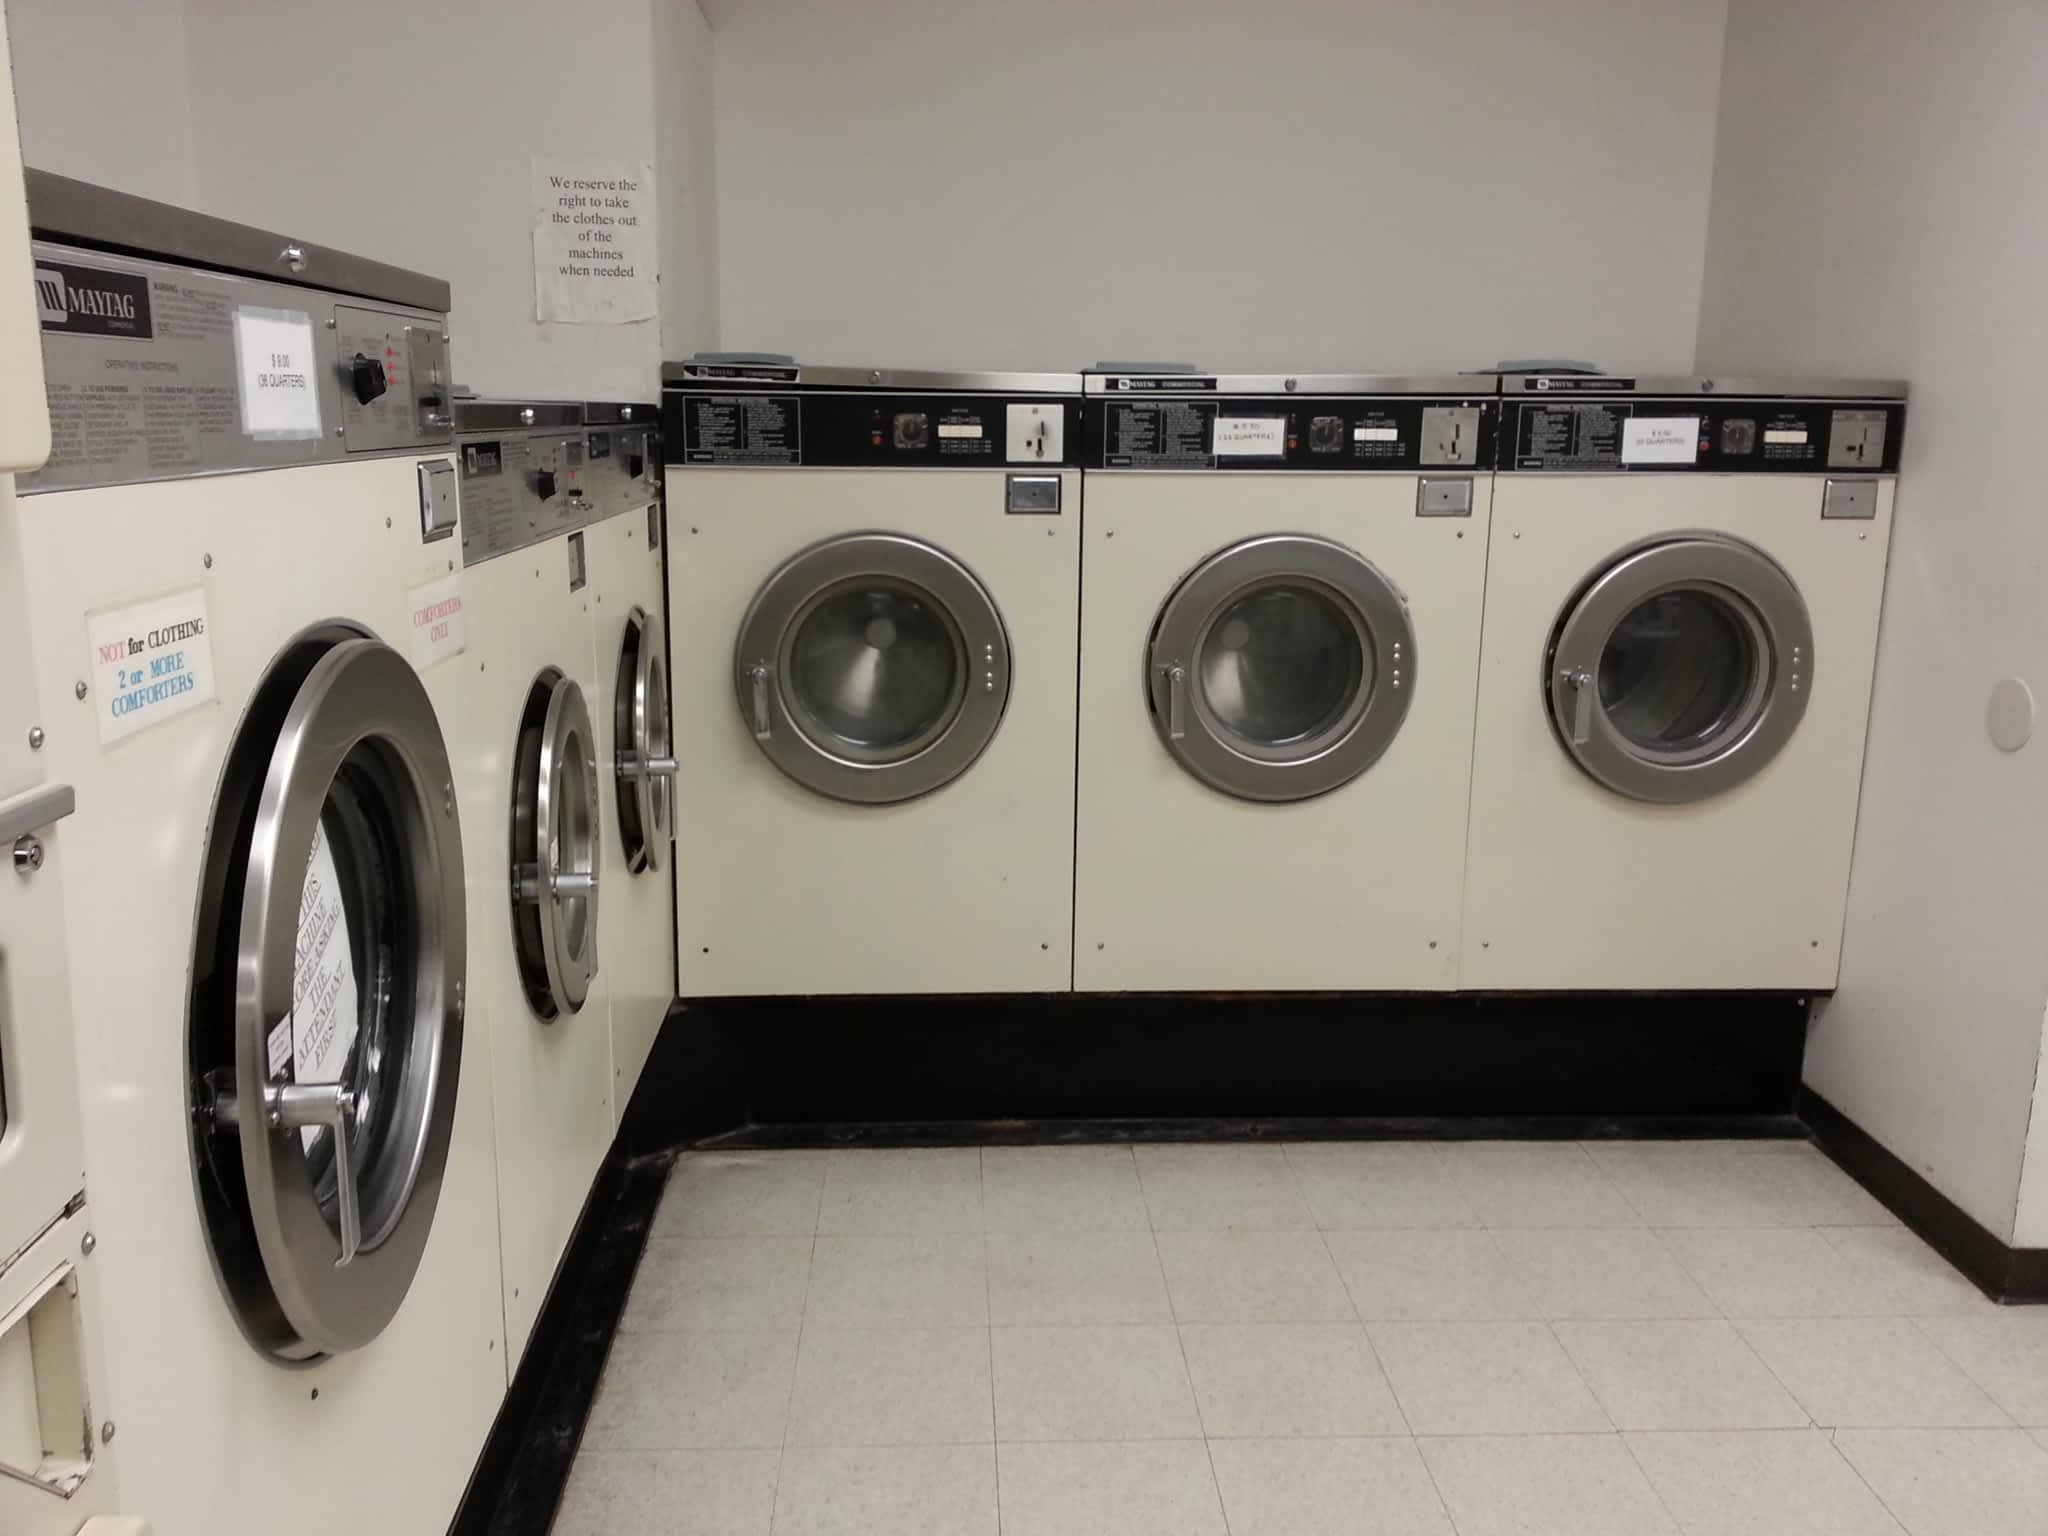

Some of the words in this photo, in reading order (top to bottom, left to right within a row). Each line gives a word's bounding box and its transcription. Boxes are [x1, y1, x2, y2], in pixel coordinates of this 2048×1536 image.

[550, 176, 570, 189] We
[573, 180, 616, 191] reserve
[619, 179, 637, 191] the
[558, 195, 586, 209] right
[590, 196, 602, 208] to
[605, 196, 629, 208] take
[552, 212, 570, 224] the
[573, 213, 615, 225] clothes
[618, 216, 637, 226] out
[578, 230, 592, 242] of
[594, 230, 612, 242] the
[568, 248, 623, 260] machines
[559, 264, 590, 276] when
[593, 266, 634, 278] needed
[67, 287, 135, 319] MAYTAG
[98, 640, 126, 664] NOT
[128, 637, 144, 656] for
[148, 617, 204, 649] CLOTHING
[118, 670, 127, 689] 2
[130, 670, 144, 685] or
[150, 651, 185, 679] MORE
[112, 672, 194, 717] COMFORTERS
[310, 965, 334, 1013] THE
[299, 959, 346, 1071] ATTENDANT
[314, 1009, 337, 1071] FIRST
